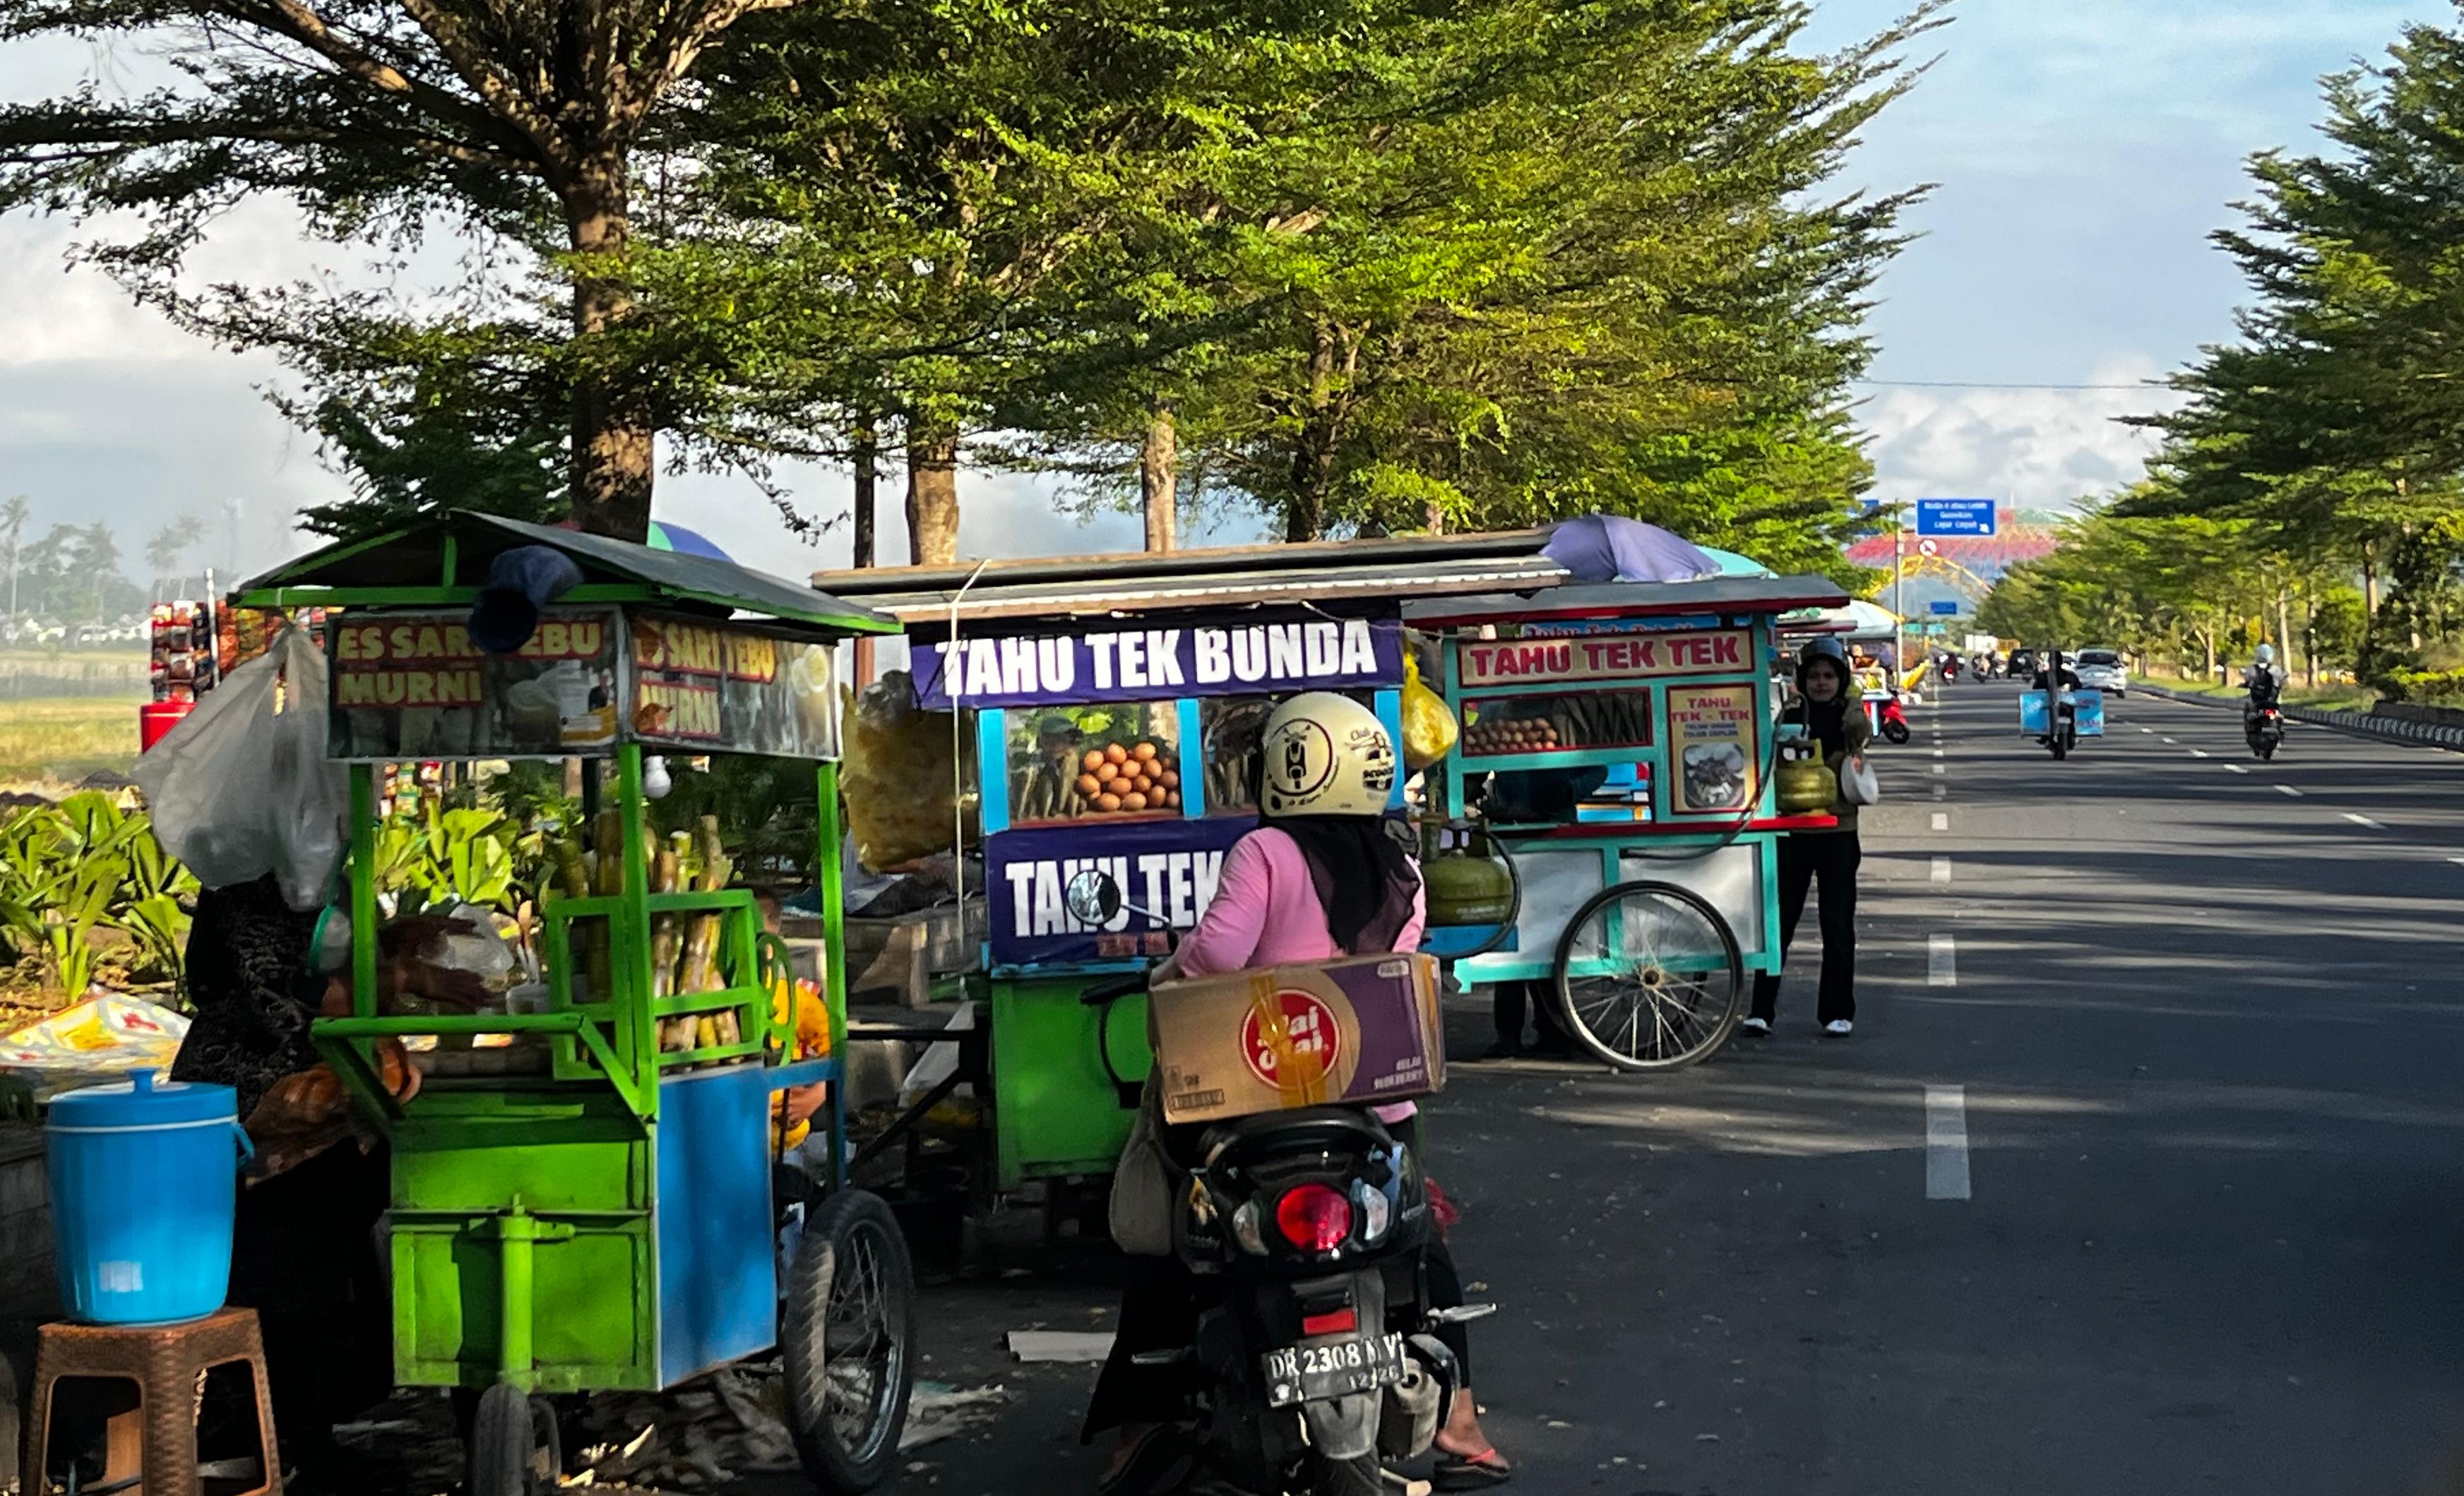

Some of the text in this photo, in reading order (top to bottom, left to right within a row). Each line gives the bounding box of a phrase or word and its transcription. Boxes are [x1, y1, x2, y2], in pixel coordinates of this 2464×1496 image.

[338, 626, 384, 659] ES
[390, 623, 486, 659] SAR
[935, 618, 1379, 697] TAHU TEK BUNDA
[1470, 636, 1740, 677] TAHU TEK TEK
[337, 671, 482, 705] MURNI
[1686, 696, 1731, 708] TAHU
[1718, 709, 1750, 721] TEK
[1270, 1351, 1301, 1378] DR
[1302, 1342, 1362, 1374] 2308
